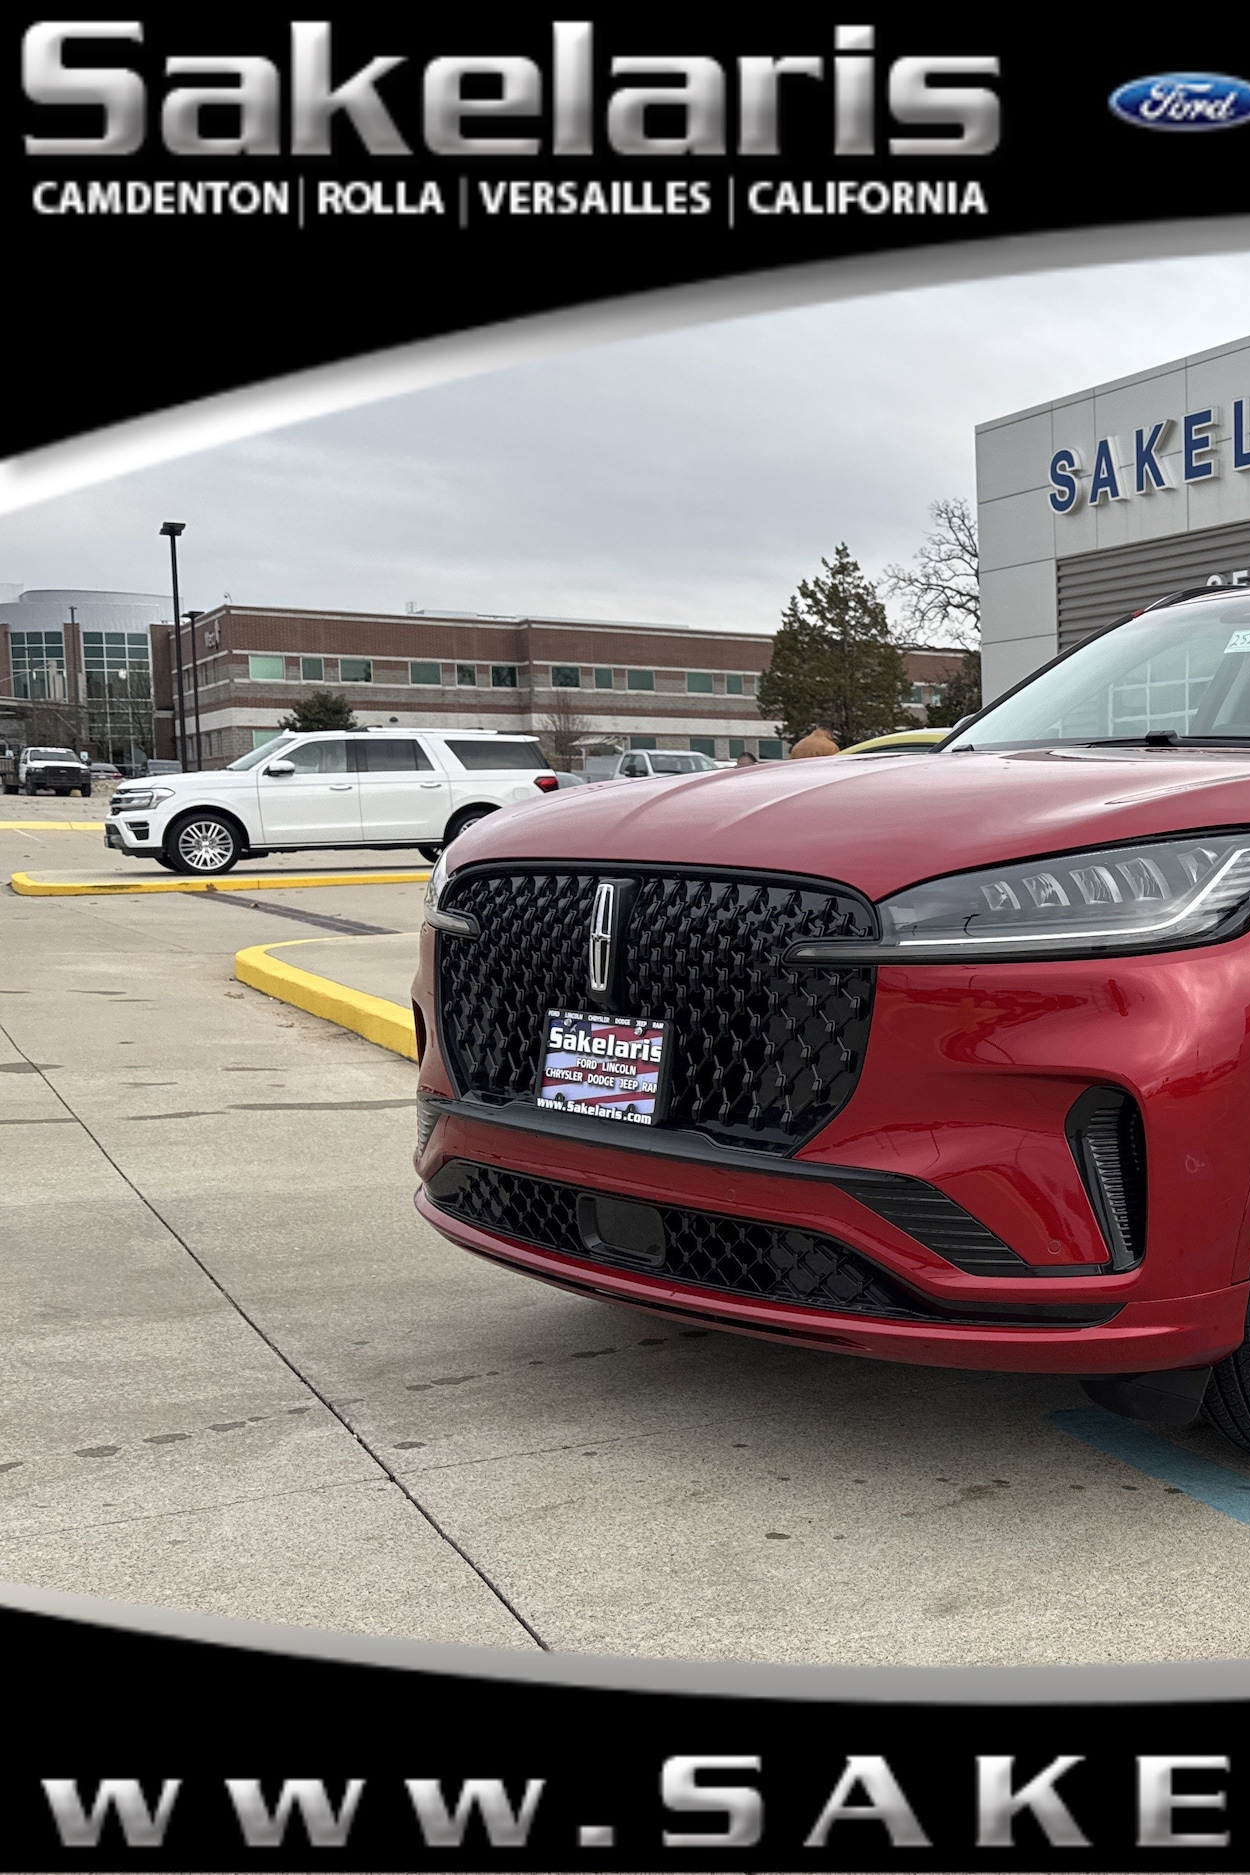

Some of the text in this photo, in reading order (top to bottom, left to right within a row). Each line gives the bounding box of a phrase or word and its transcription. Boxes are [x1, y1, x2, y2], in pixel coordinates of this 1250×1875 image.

[565, 1012, 583, 1020] LINCOLN
[588, 1015, 610, 1023] CHRYSLER
[615, 1018, 631, 1026] DODGE
[636, 1020, 648, 1028] JEEP
[550, 1027, 662, 1063] Sakelaris
[576, 1057, 637, 1076] FORD LINCOLN
[546, 1067, 583, 1082] CHRYSLER
[587, 1074, 614, 1087] DODGE
[619, 1078, 639, 1090] JEEP
[537, 1097, 652, 1125] www.Sakelaris.com
